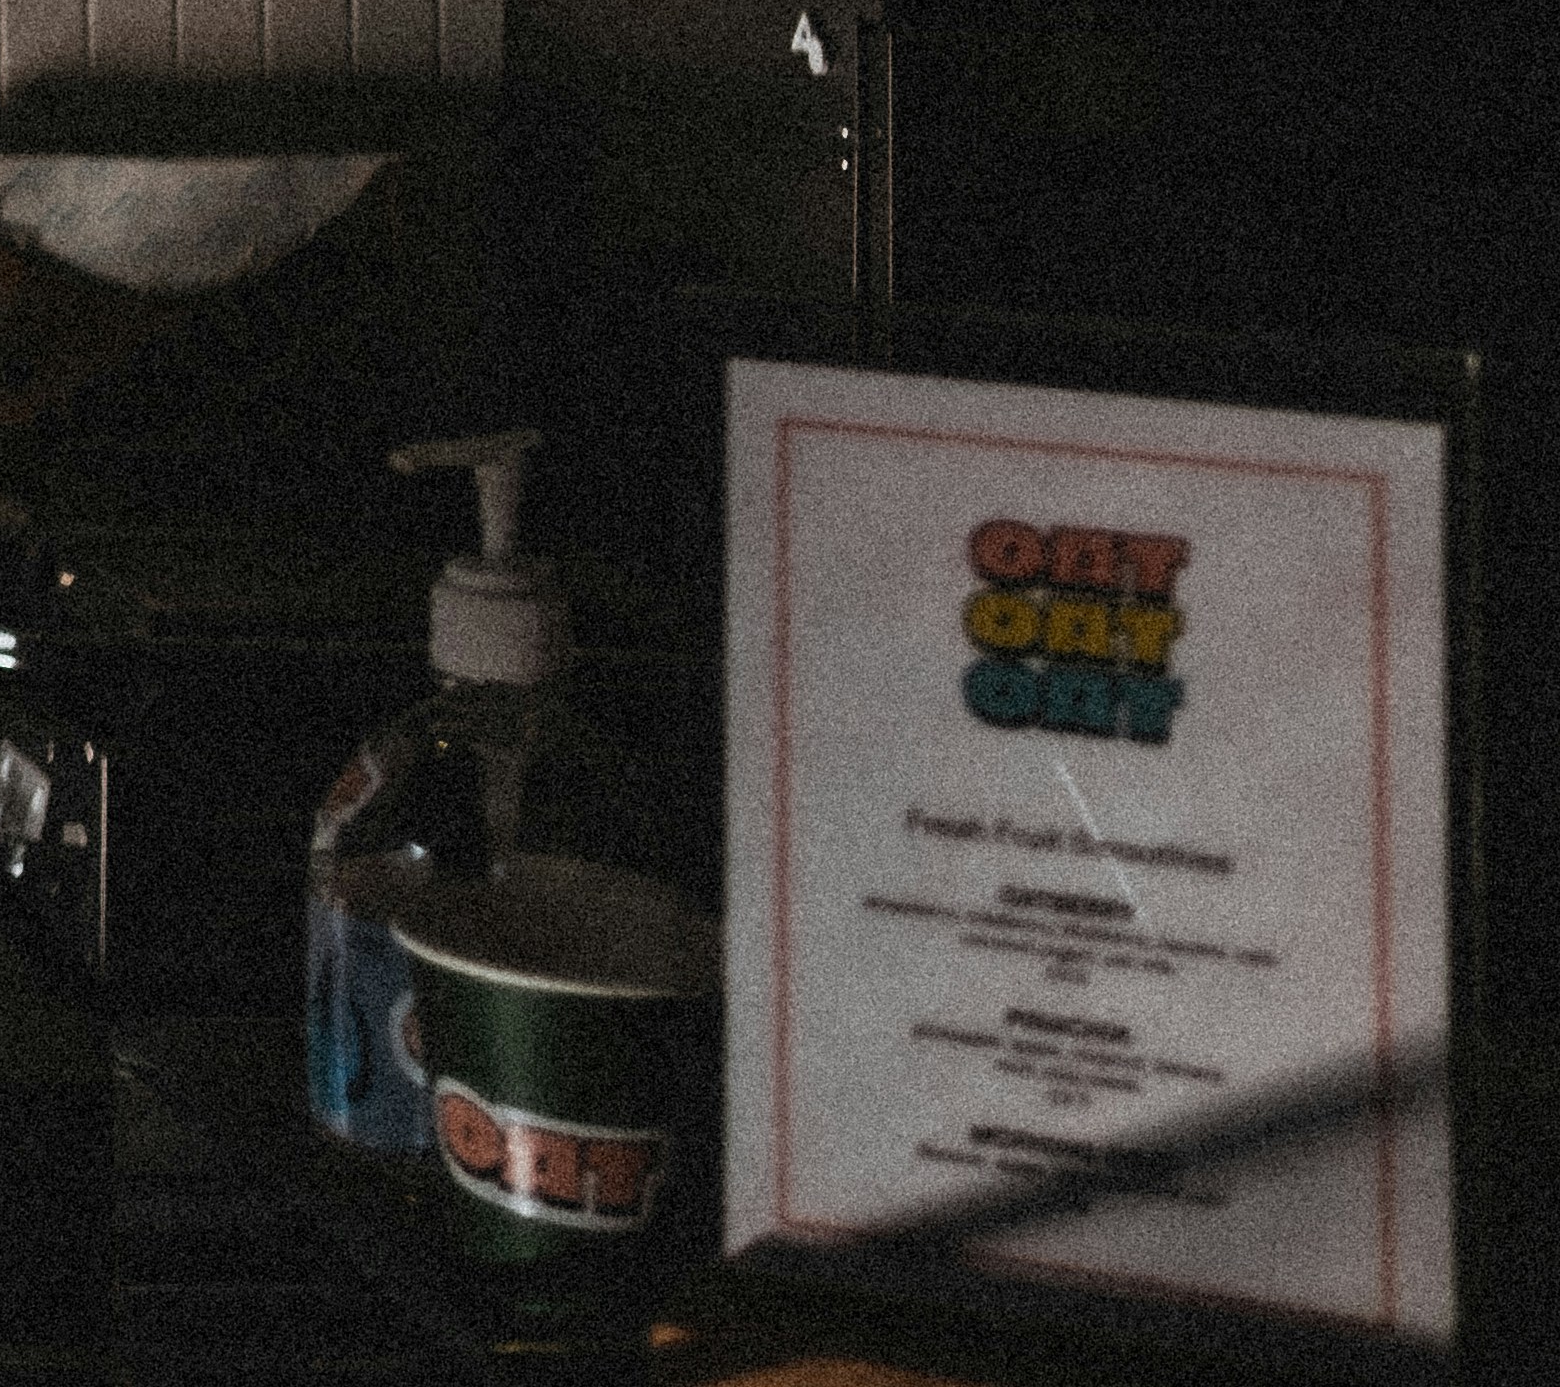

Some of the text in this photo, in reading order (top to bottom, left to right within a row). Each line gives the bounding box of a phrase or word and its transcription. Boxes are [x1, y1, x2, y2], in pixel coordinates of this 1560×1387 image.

[968, 518, 1191, 605] OAT
[962, 589, 1185, 674] OAT
[962, 659, 1185, 748] OAT
